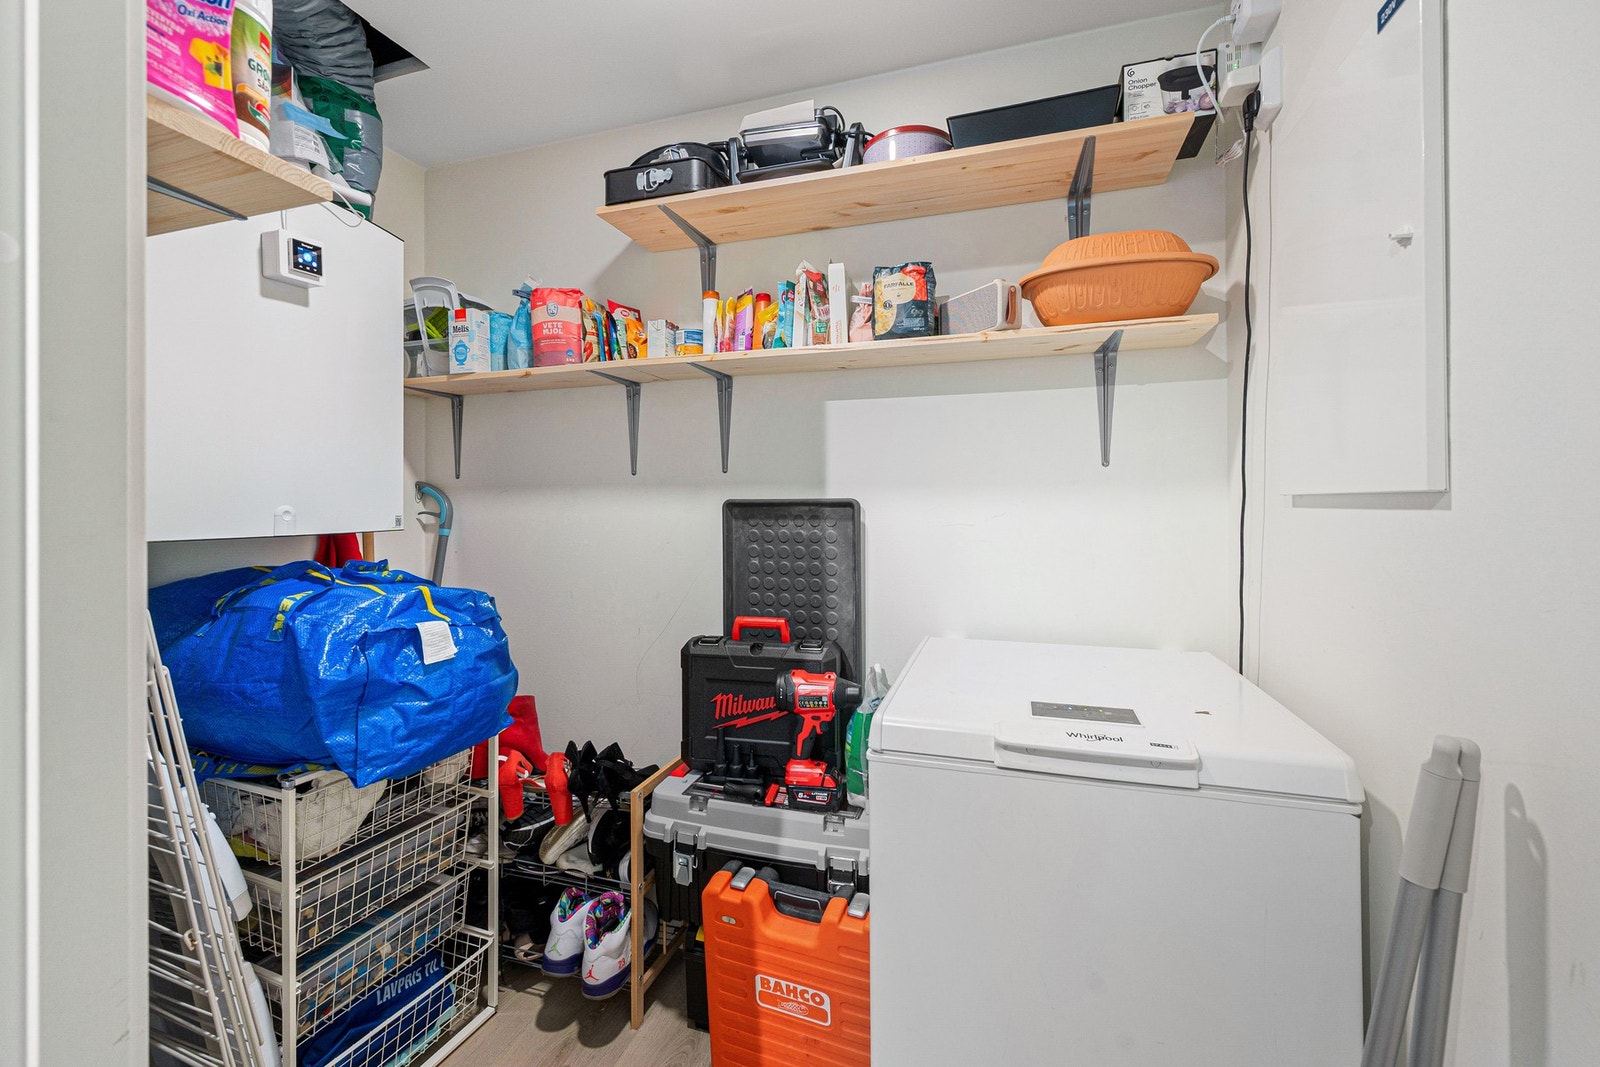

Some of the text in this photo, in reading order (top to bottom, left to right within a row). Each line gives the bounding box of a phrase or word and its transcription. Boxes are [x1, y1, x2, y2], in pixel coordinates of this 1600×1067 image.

[177, 4, 195, 17] Oxi
[197, 11, 228, 26] Action
[1128, 82, 1156, 91] Chopper
[883, 281, 914, 289] FARFALLE
[452, 324, 470, 333] Melis
[710, 691, 776, 720] Milwau
[1065, 731, 1124, 743] Whirlpool
[617, 957, 626, 971] 23
[376, 967, 423, 1006] LAVPRIS
[424, 957, 440, 977] TIL
[759, 976, 825, 1007] BAHCO
